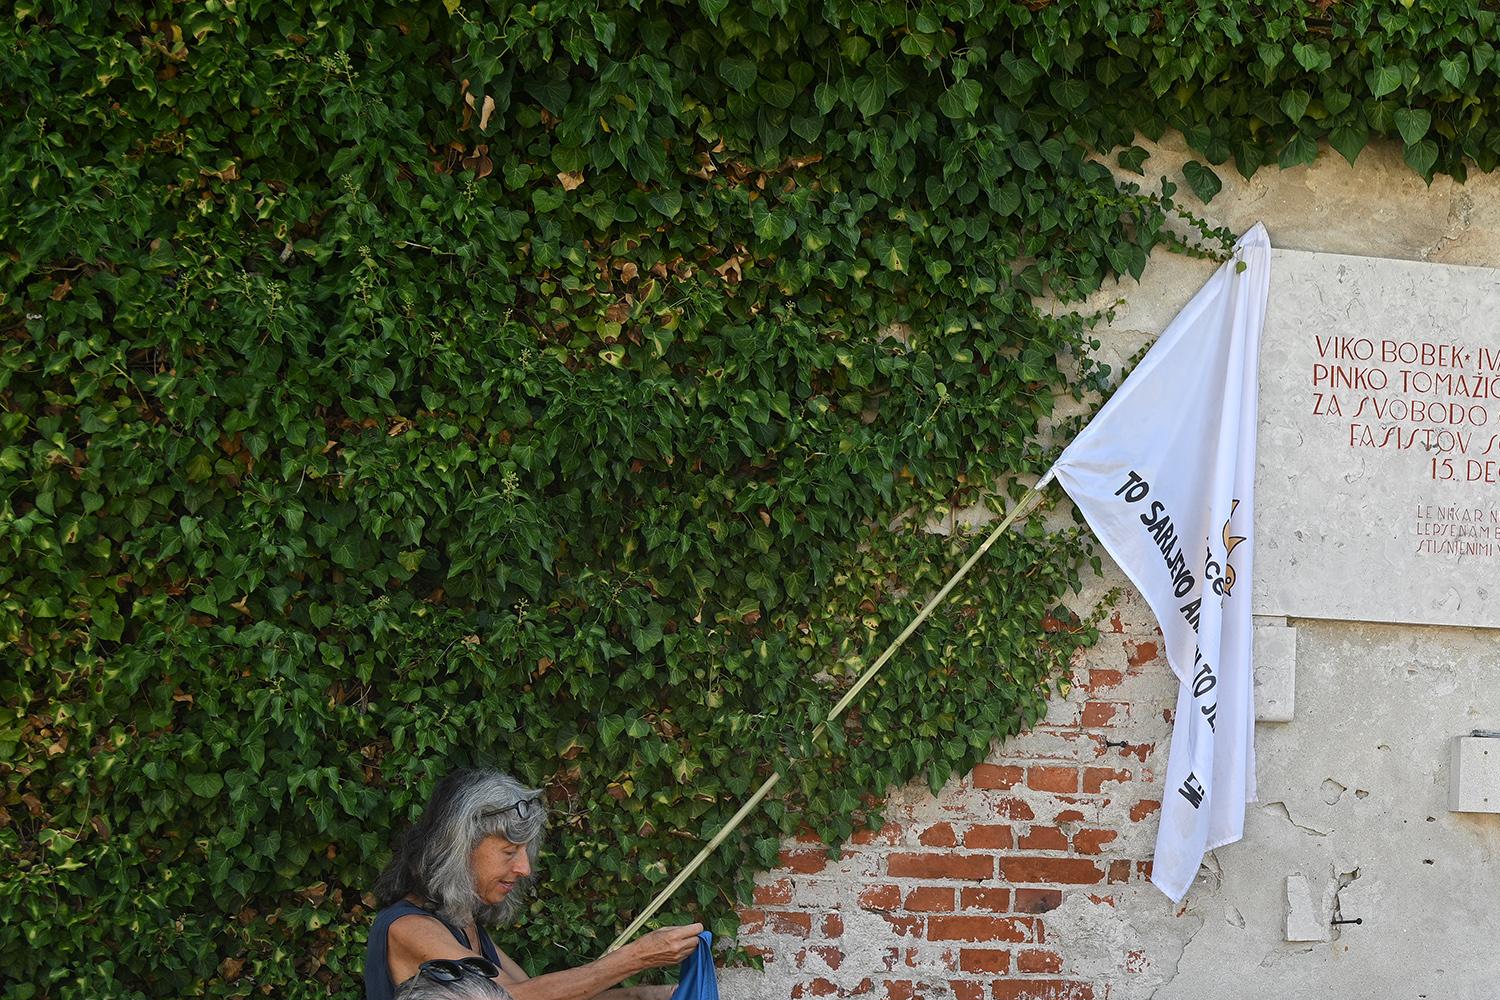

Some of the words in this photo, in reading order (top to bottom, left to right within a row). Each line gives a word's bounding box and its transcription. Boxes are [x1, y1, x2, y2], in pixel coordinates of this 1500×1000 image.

[1315, 335, 1373, 361] VIKO
[1382, 340, 1464, 368] BOBEK
[1313, 364, 1388, 390] PINKO
[1313, 393, 1342, 416] ZA
[1353, 396, 1487, 426] SVOBODO
[1350, 424, 1472, 454] FAŠISTOV
[1431, 458, 1456, 481] 15.
[1417, 505, 1433, 519] LE
[1114, 470, 1149, 503] TO
[1140, 500, 1196, 598] SARAJEVO
[1180, 597, 1201, 634] AN
[1192, 664, 1217, 698] TO
